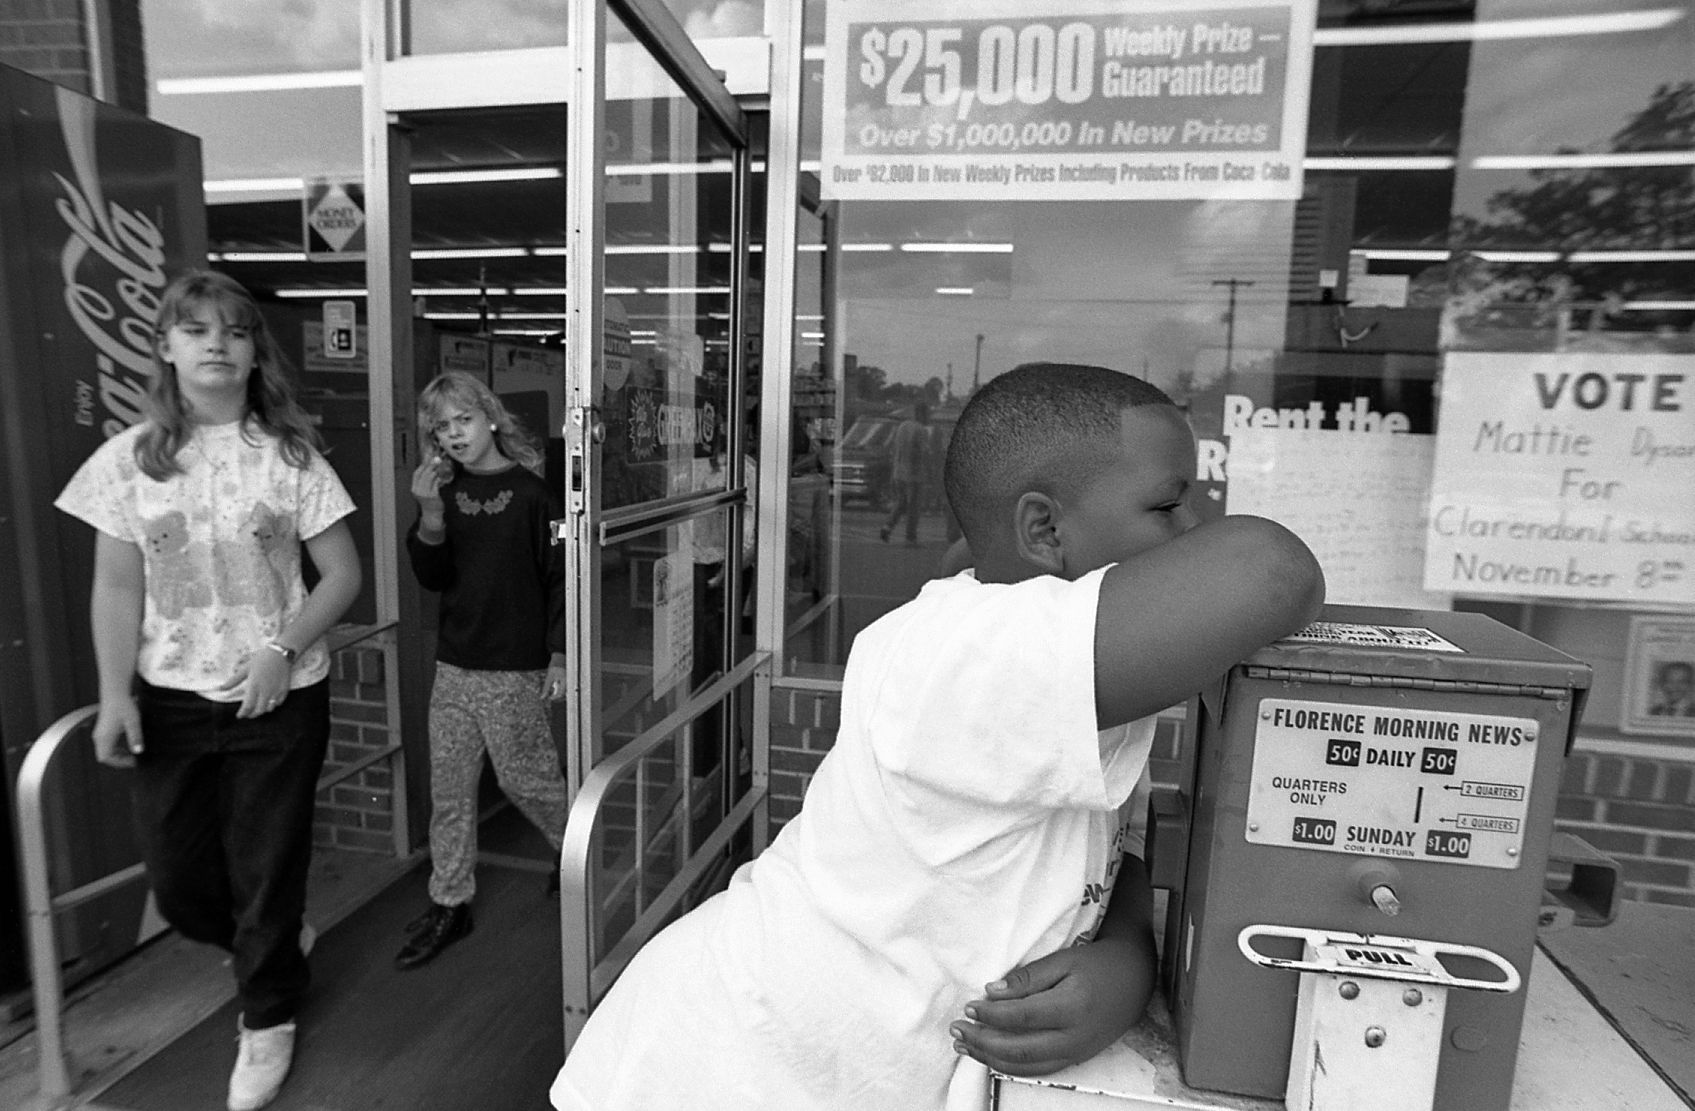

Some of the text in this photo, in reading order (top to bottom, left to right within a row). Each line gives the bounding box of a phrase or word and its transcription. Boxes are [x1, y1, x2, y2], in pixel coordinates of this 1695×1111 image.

[1104, 25, 1187, 59] Weekly
[1192, 22, 1253, 54] Prize
[860, 22, 1096, 120] $25,000
[1103, 57, 1266, 98] Guaranteed
[860, 119, 1267, 150] Over $1,000,000 In New Prizes
[833, 165, 861, 182] Over
[934, 165, 961, 182] New
[965, 164, 1011, 186] Weekly
[1015, 164, 1055, 182] Prizes
[1184, 162, 1219, 181] From
[74, 379, 94, 426] Enjoy
[1533, 372, 1685, 412] VOTE
[1223, 394, 1410, 435] Rent the
[1473, 421, 1593, 456] Mattie
[1559, 468, 1621, 500] For
[1452, 552, 1615, 588] November
[1273, 708, 1523, 747] FLORENCE MORNING NEWS
[1330, 744, 1455, 771] 50¢ DAILY 50¢
[1272, 777, 1347, 794] QUARTERS
[1290, 792, 1326, 806] ONLY
[1466, 785, 1519, 799] 2 QUARTERS
[1295, 822, 1469, 855] $1.00 SUNDAY $1.00
[1471, 817, 1514, 831] QUARTERS
[1344, 844, 1415, 857] COIN RETURN
[1345, 949, 1412, 966] PULL
